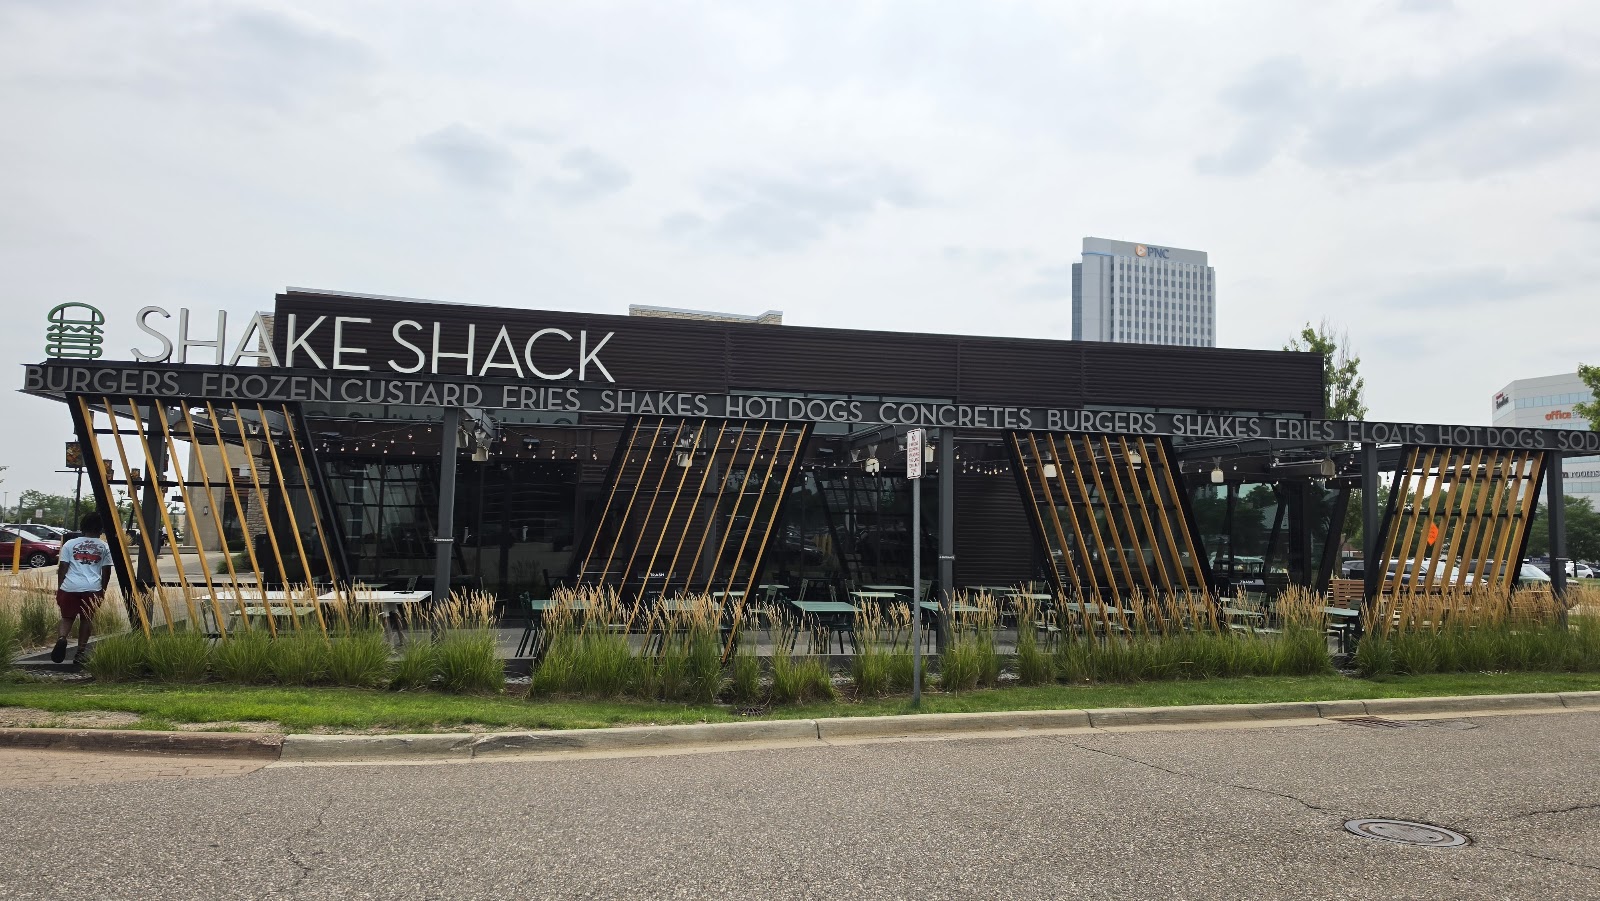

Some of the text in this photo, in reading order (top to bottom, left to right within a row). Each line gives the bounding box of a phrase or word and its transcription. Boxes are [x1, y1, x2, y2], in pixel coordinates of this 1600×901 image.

[1146, 246, 1170, 259] PNC
[131, 305, 616, 383] SHAKE SHACK
[25, 365, 1600, 450] BURGERS FROZEN CUSTARD FRIES SHAKES HOT DOGS CONCRETES BURGERS SHAKES FRIES FLOATS HOT DOGS SOD
[1545, 409, 1572, 422] office
